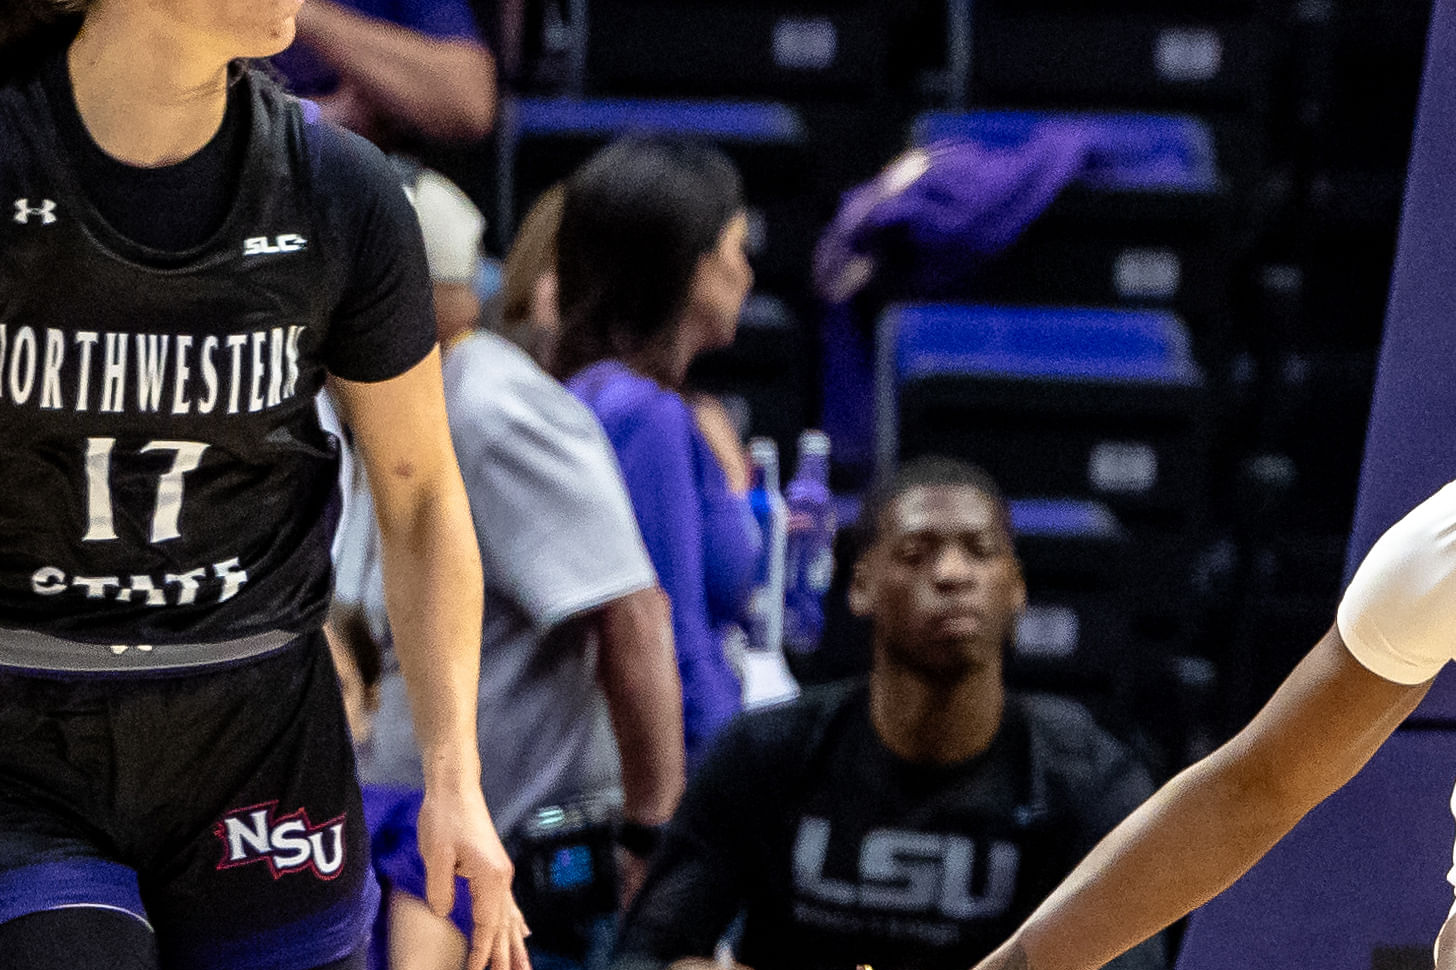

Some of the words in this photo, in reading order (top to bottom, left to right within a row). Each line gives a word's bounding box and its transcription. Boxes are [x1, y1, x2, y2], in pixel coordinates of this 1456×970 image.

[243, 233, 308, 256] SLC
[82, 437, 211, 543] 17
[32, 557, 248, 606] STATE
[222, 808, 344, 875] NSU
[792, 815, 1021, 920] LSU
